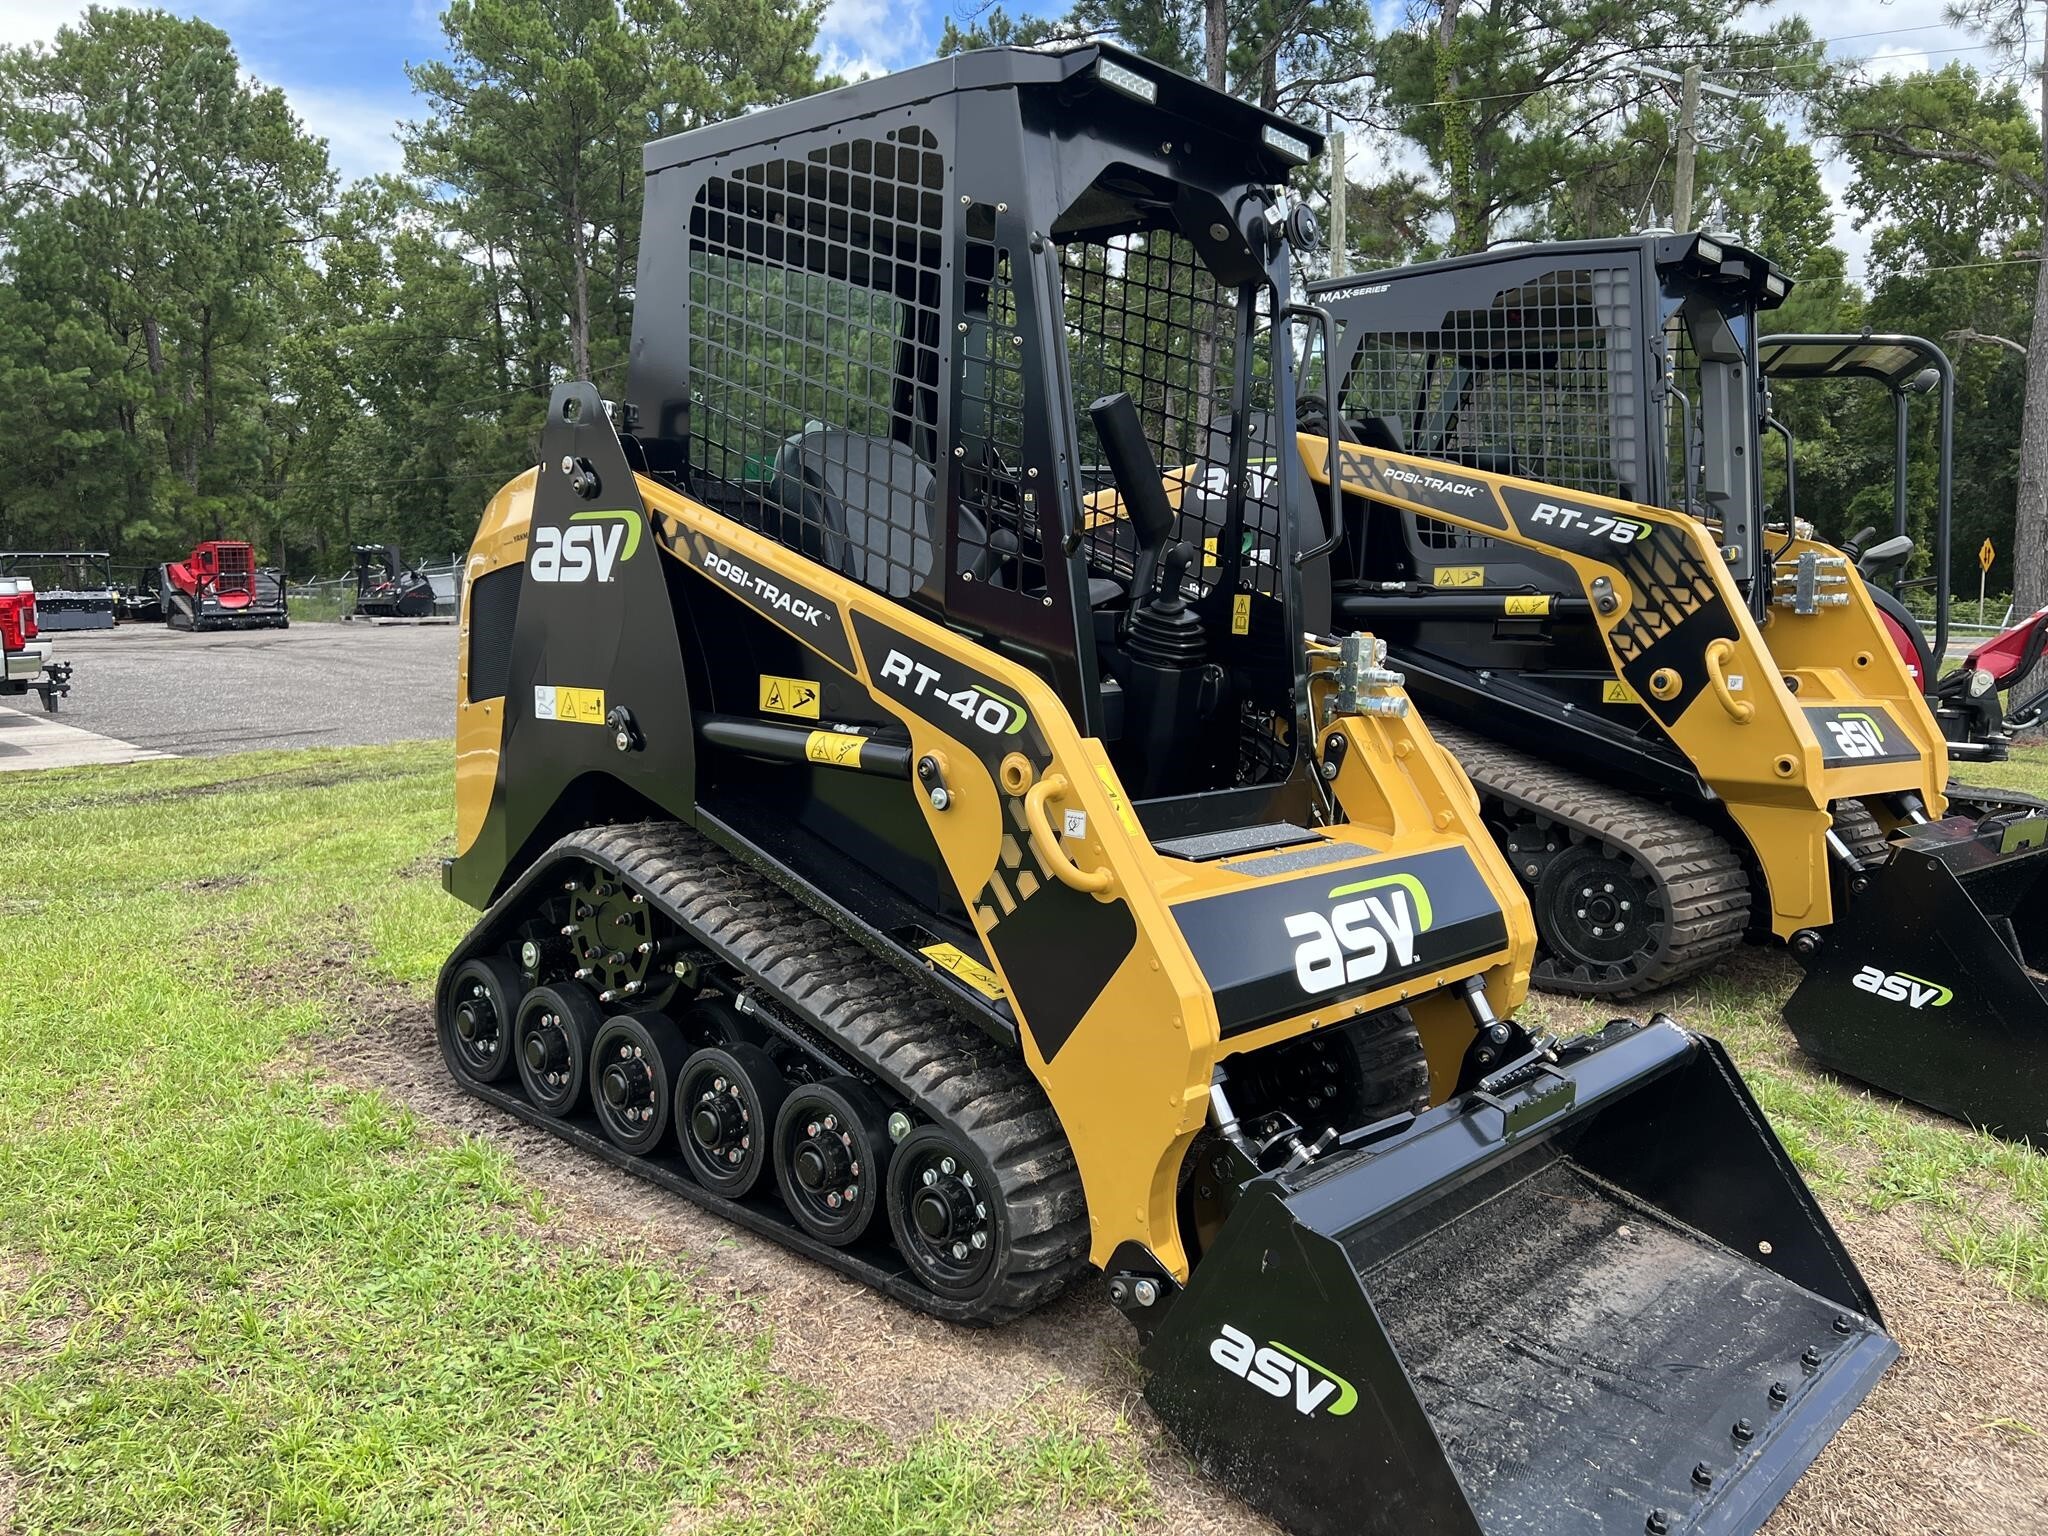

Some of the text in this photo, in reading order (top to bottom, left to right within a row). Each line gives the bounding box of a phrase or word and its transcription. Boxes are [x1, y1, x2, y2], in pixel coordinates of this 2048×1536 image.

[1383, 467, 1478, 498] POSI-TRACK
[530, 523, 625, 582] asv
[1530, 502, 1639, 544] RT-75
[703, 551, 823, 627] POSI-TRACK
[880, 648, 1010, 735] RT-40
[1825, 720, 1886, 758] asv
[1283, 889, 1414, 995] asv
[1852, 965, 1940, 1009] asv
[1209, 1323, 1337, 1416] asv
